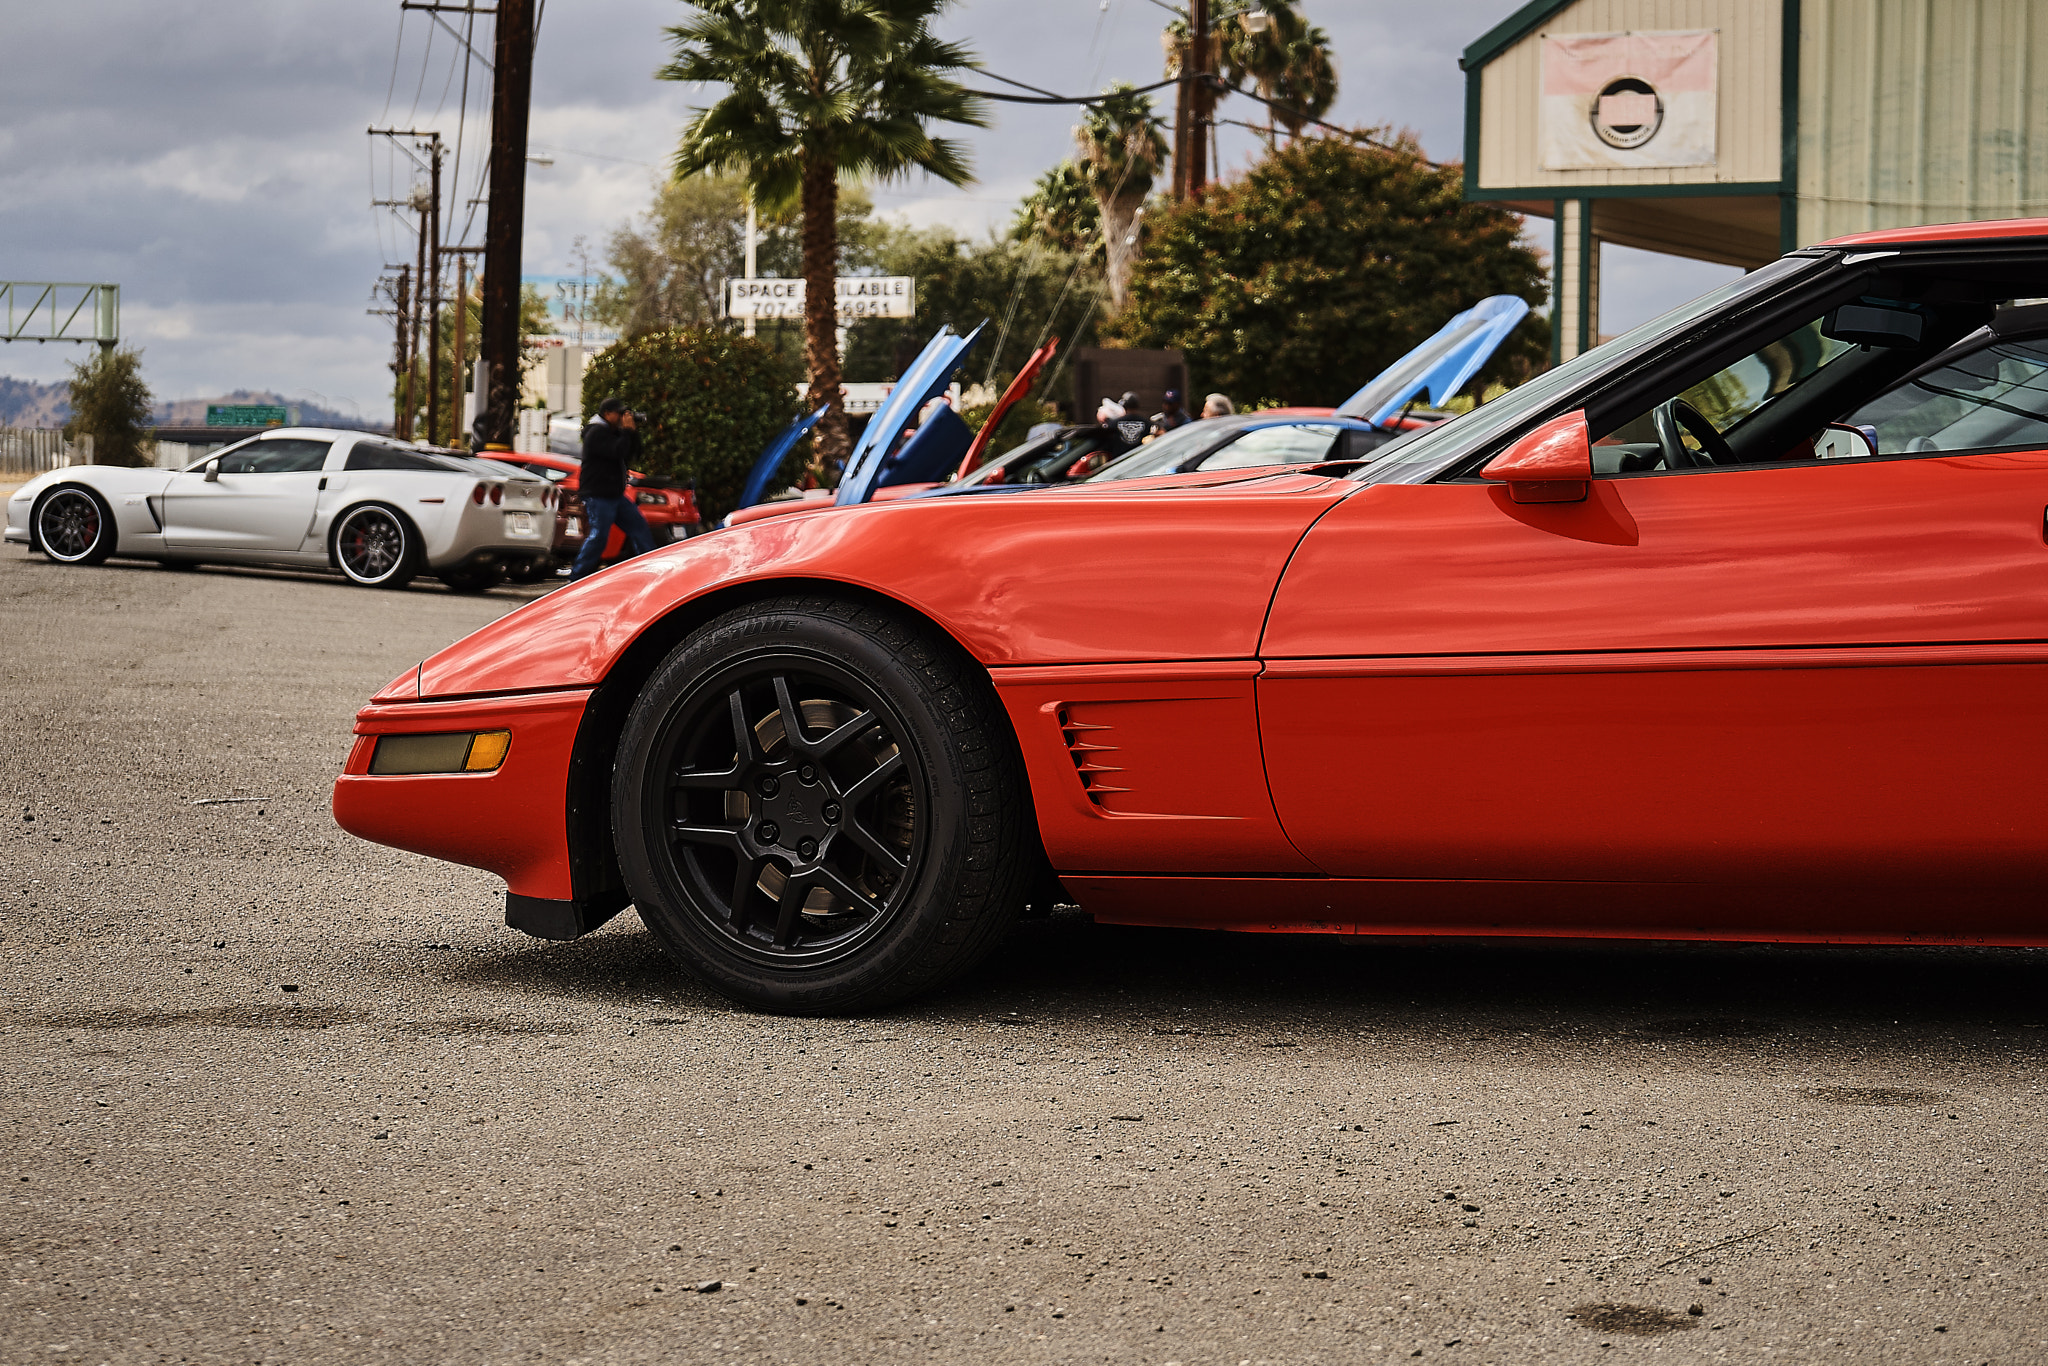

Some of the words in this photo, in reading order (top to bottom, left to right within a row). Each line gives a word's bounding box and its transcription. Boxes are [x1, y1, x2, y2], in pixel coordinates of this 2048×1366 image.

[737, 283, 797, 298] SPACE
[840, 281, 904, 297] ILABLE
[642, 619, 801, 731] BRIDGESTONE
[788, 911, 934, 1006] POTENZA
